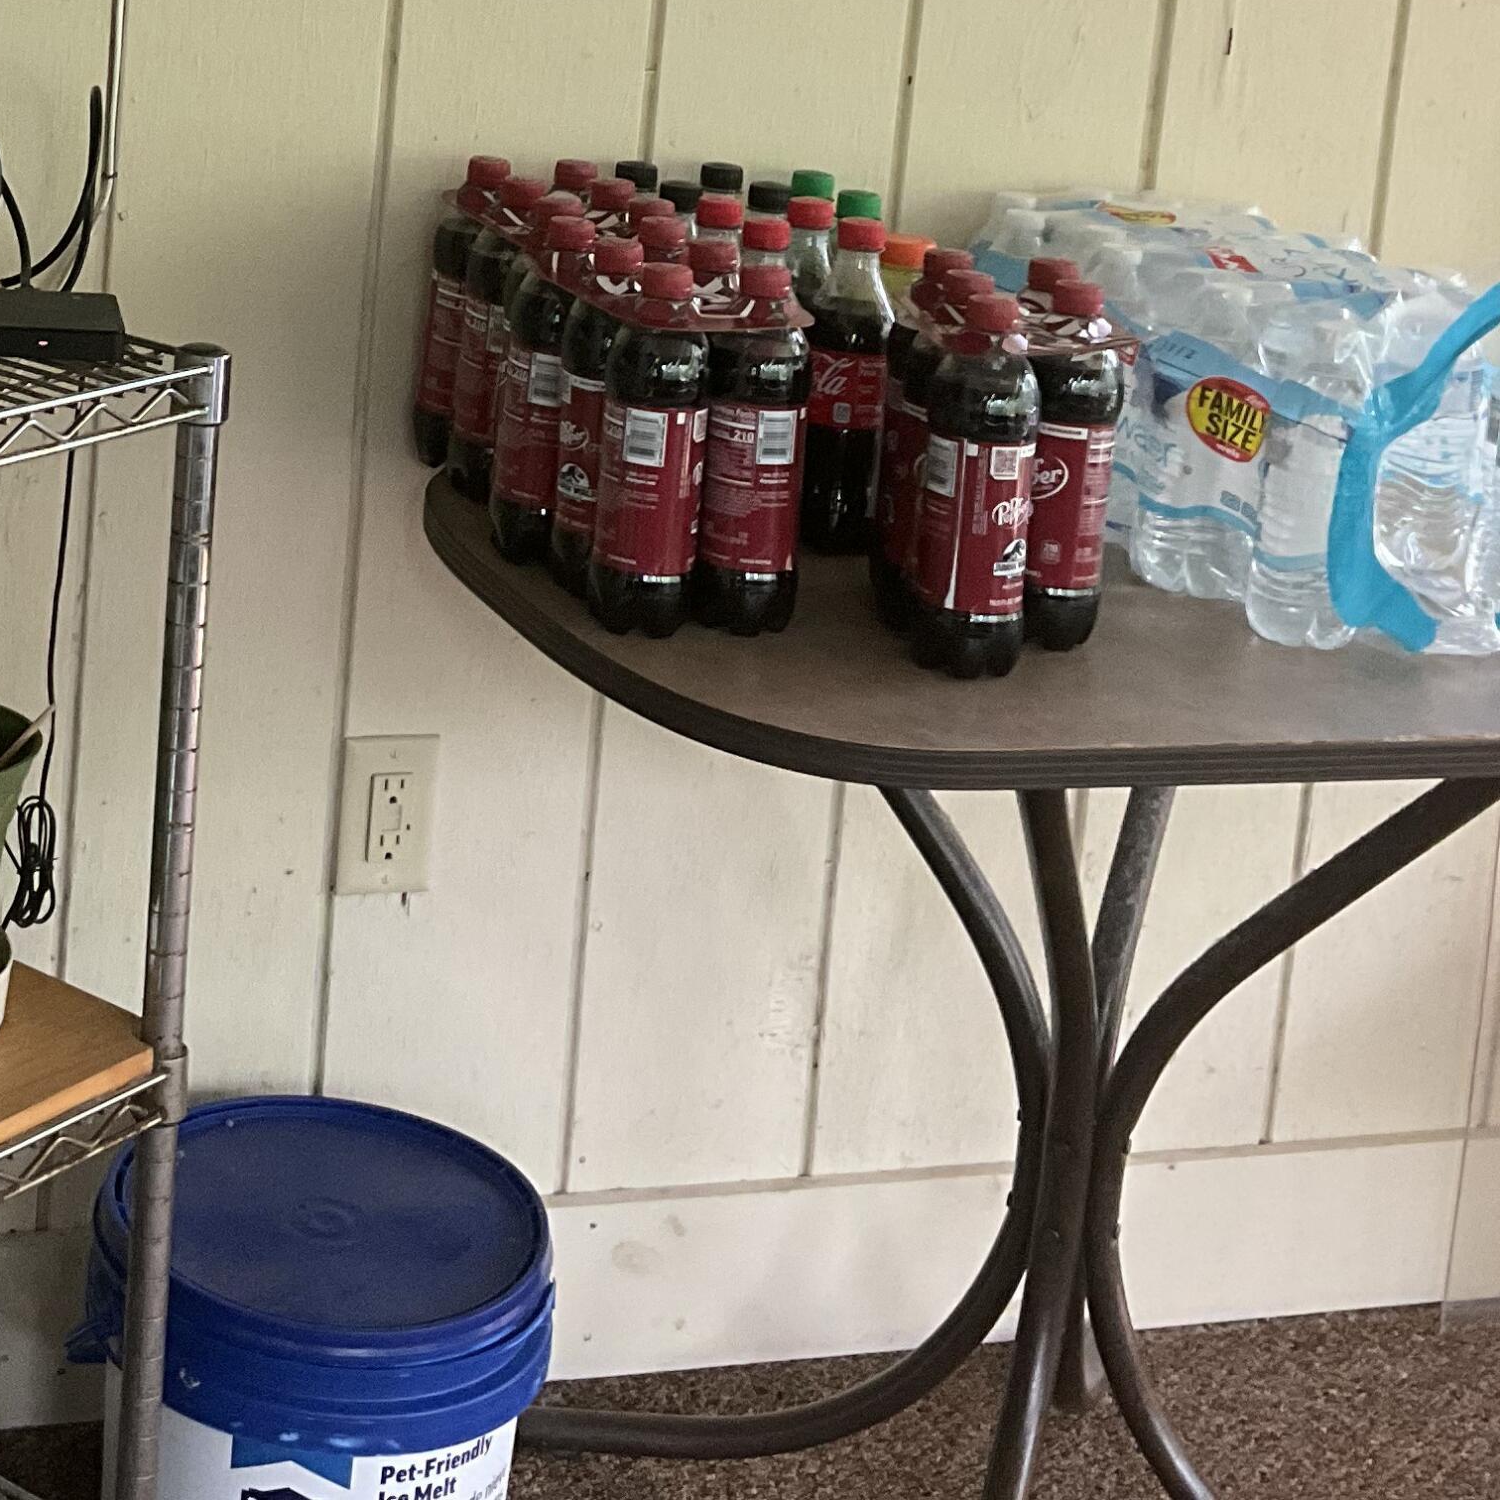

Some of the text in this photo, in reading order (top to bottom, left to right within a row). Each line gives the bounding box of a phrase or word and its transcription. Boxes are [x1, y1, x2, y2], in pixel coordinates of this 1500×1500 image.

[733, 429, 755, 444] 210
[1204, 412, 1256, 453] SIZE
[380, 1435, 493, 1485] Pet-Friendly
[413, 1476, 457, 1500] Melt
